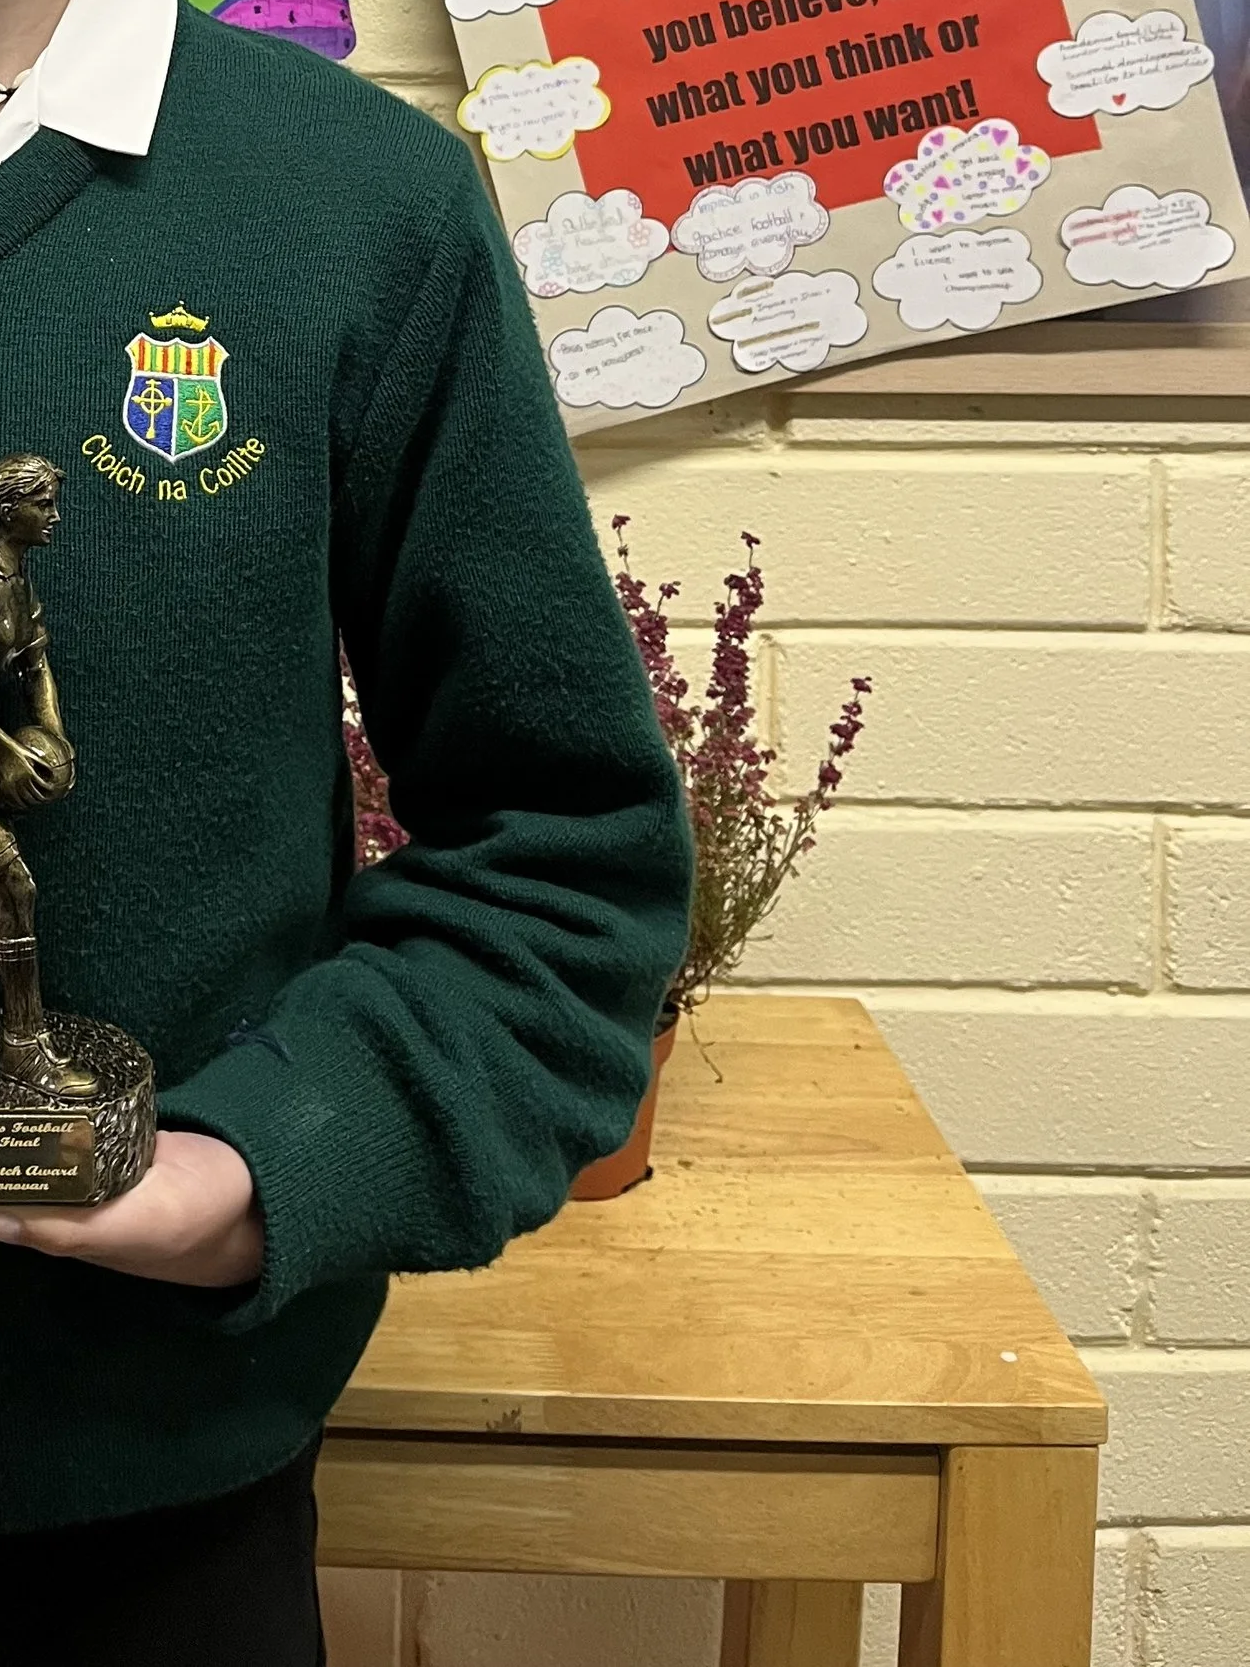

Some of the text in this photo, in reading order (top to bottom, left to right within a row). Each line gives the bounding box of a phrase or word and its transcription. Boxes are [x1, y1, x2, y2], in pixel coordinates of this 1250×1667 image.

[641, 12, 717, 64] you
[645, 13, 981, 130] what you think or
[682, 78, 981, 189] what you want!
[81, 434, 266, 501] Cloich na Coillte
[11, 1122, 75, 1134] Football
[25, 1165, 79, 1177] Award
